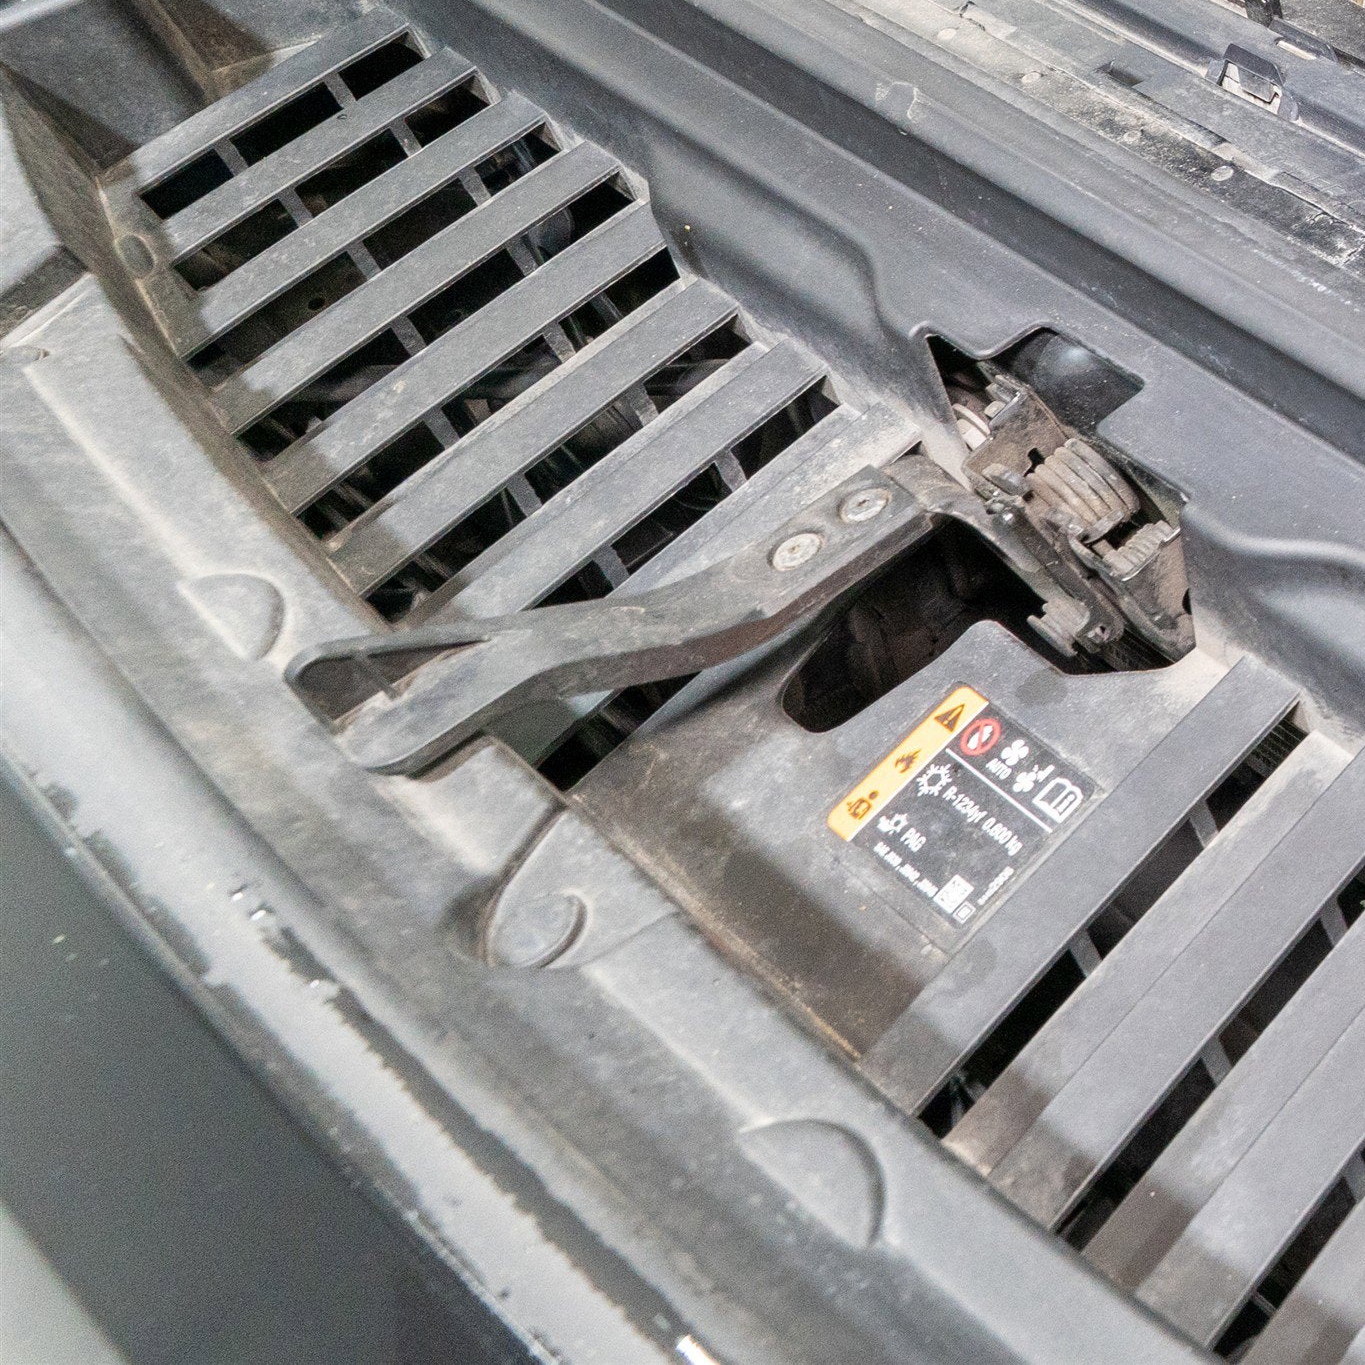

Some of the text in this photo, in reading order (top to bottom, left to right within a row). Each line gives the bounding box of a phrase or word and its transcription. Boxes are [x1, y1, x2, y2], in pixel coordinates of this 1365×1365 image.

[986, 758, 1012, 780] AUTO
[942, 786, 987, 823] R-1234yf
[1005, 835, 1023, 856] kg
[900, 827, 926, 852] PAG
